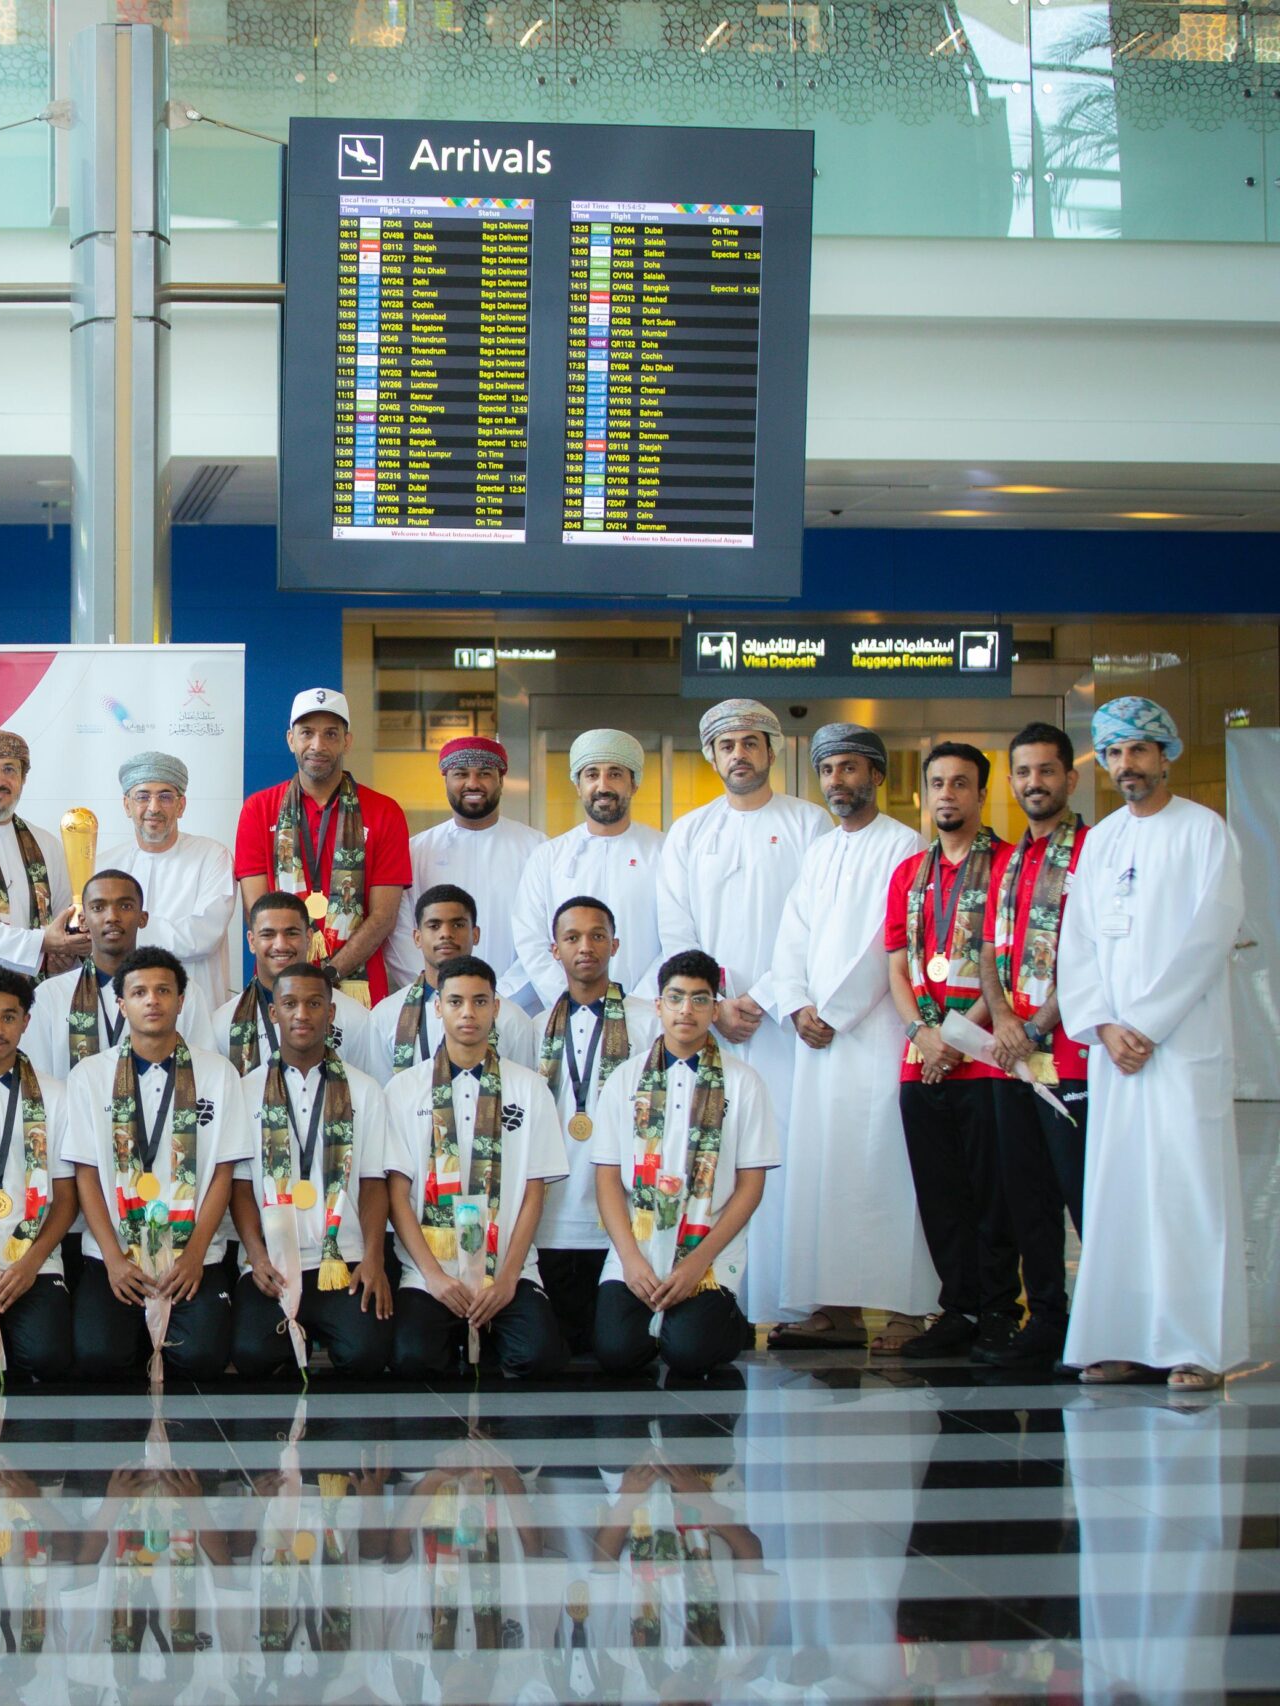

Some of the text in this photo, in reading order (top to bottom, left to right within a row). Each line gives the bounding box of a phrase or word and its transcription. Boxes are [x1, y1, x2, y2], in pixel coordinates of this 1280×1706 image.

[409, 138, 552, 175] Arrivals
[361, 197, 379, 205] Time
[340, 206, 500, 218] Time Flight From Status
[572, 212, 730, 224] Time Flight From Status
[573, 225, 589, 233] 12:25
[644, 226, 663, 234] Dubai
[340, 230, 357, 238] 08:15
[413, 232, 434, 240] Dhaka
[481, 233, 497, 242] Bags
[498, 233, 528, 241] Delivered
[340, 253, 357, 261] 10:00
[413, 255, 432, 263] Shiraz
[481, 256, 497, 265] Bags
[497, 256, 527, 264] Delivered
[643, 249, 665, 258] Sialkot
[711, 250, 739, 259] Expected
[744, 252, 760, 260] 12:36
[571, 270, 587, 278] 14:05
[643, 272, 665, 281] Salalah
[412, 277, 429, 286] Delhi
[481, 278, 496, 288] Bags
[497, 279, 527, 287] Delivered
[571, 293, 587, 301] 15:10
[642, 295, 668, 303] Mashad
[339, 299, 356, 307] 10:50
[411, 300, 435, 309] Cochin
[480, 302, 496, 311] Bags
[496, 302, 526, 310] Delivered
[339, 322, 355, 330] 10:50
[411, 323, 443, 333] Bangalore
[480, 324, 495, 333] Bags
[496, 325, 526, 333] Delivered
[569, 339, 586, 347] 16:05
[641, 340, 659, 349] Doha
[339, 345, 354, 353] 11:00
[411, 346, 446, 355] Trivandrum
[479, 348, 495, 356] Bags
[495, 348, 525, 356] Delivered
[569, 361, 585, 370] 17:35
[655, 363, 673, 372] Dhabi
[409, 392, 432, 400] Kannur
[478, 393, 507, 402] Expected
[511, 394, 528, 402] 13:40
[337, 414, 354, 422] 11:30
[409, 415, 427, 423] Doha
[478, 416, 493, 425] Bags
[503, 416, 516, 424] Belt
[567, 430, 583, 438] 18:50
[639, 431, 669, 440] Dammam
[408, 438, 436, 448] Bangkok
[477, 439, 506, 447] Expected
[510, 440, 526, 448] 12:10
[565, 498, 581, 506] 19:45
[637, 500, 655, 508] Dubai
[336, 505, 351, 513] 12:25
[407, 506, 434, 515] Zanzibar
[486, 507, 502, 515] Time
[564, 521, 580, 529] 20:45
[636, 523, 667, 531] Dammam
[743, 655, 816, 670] Visa Deposit
[852, 655, 953, 670] Baggage Enquiries
